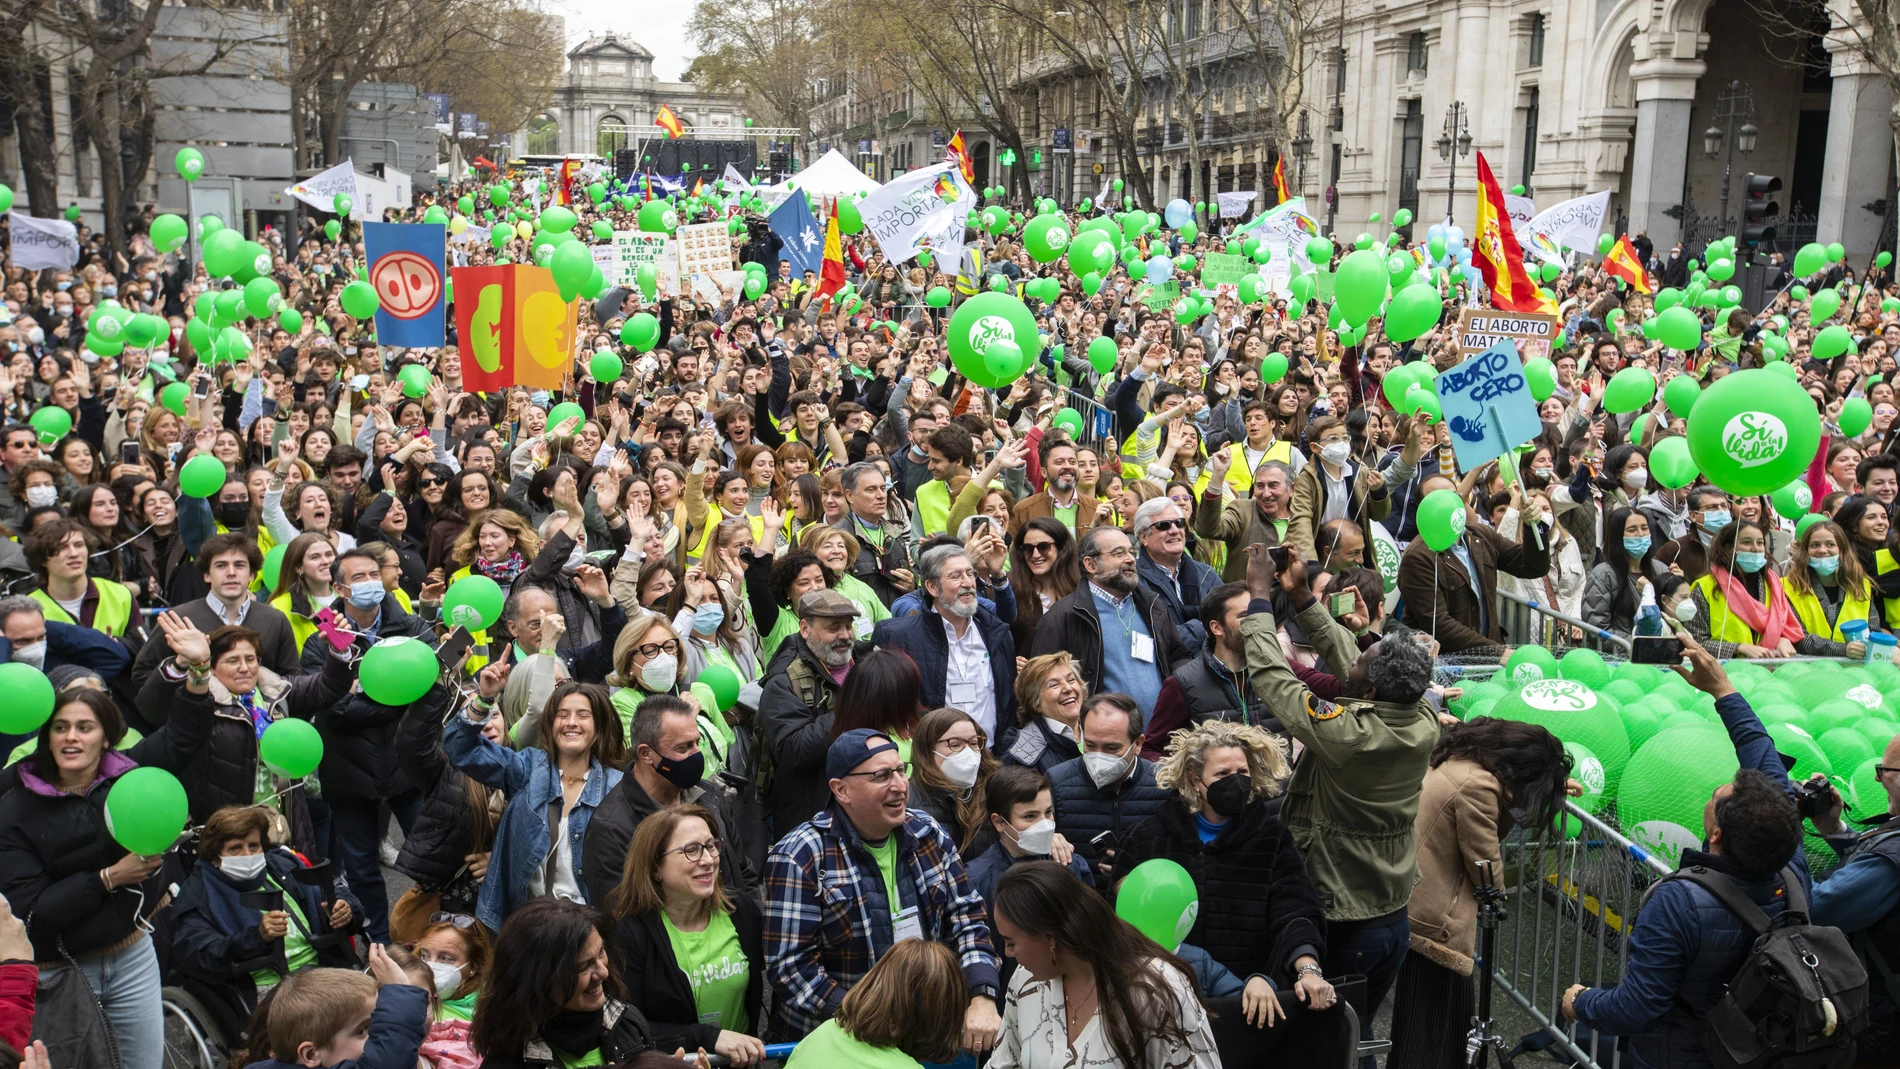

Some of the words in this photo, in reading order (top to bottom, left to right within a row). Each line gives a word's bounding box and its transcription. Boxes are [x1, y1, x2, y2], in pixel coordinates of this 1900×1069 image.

[868, 205, 904, 229] CADA
[902, 184, 932, 207] VIDA
[875, 195, 943, 242] IMPORTA
[980, 318, 1003, 339] Sí
[1470, 318, 1486, 331] EL
[1490, 319, 1548, 334] ABORTO
[1441, 352, 1508, 396] ABORTO
[1470, 373, 1524, 401] CERO
[1740, 413, 1773, 441] Sí
[1726, 432, 1784, 461] Vida!
[1519, 664, 1536, 679] Sí
